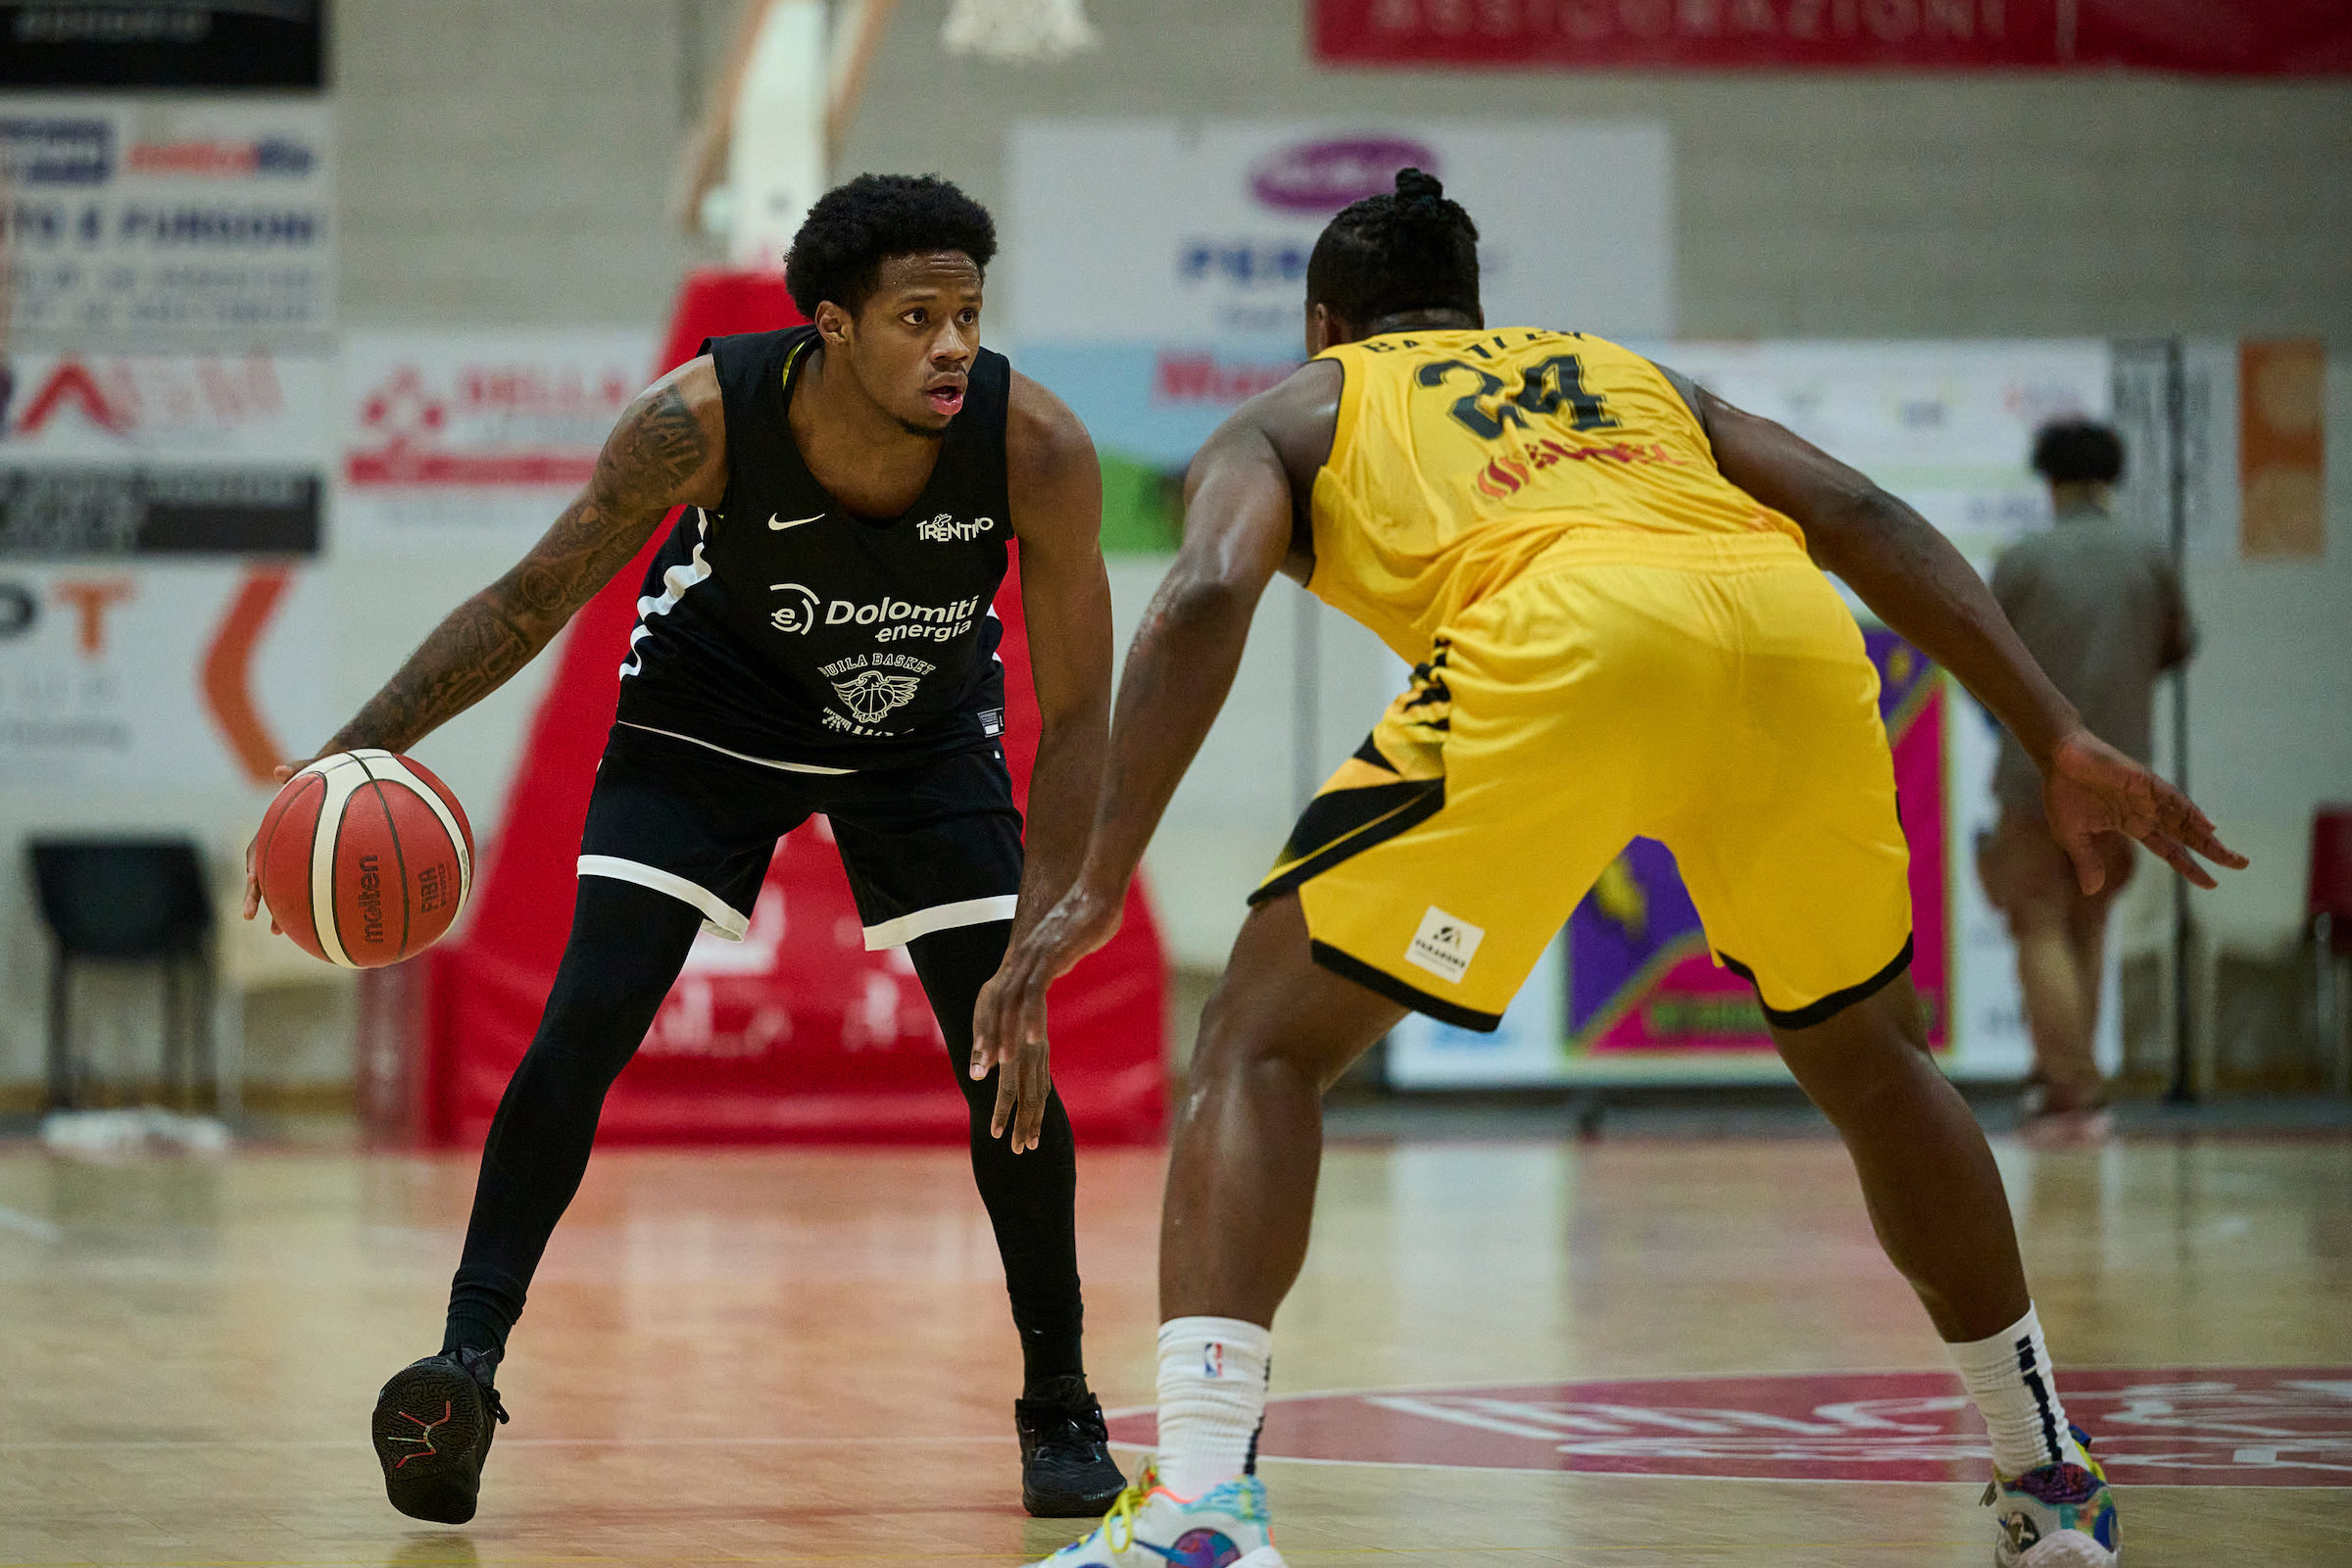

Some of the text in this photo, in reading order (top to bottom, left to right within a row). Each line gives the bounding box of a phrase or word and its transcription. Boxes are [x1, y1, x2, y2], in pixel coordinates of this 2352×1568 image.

[1414, 354, 1623, 441] 24
[824, 594, 980, 626] Dolomiti
[874, 619, 973, 643] energia
[872, 653, 936, 675] BASKET
[359, 855, 383, 944] molten
[418, 867, 438, 913] FIBA
